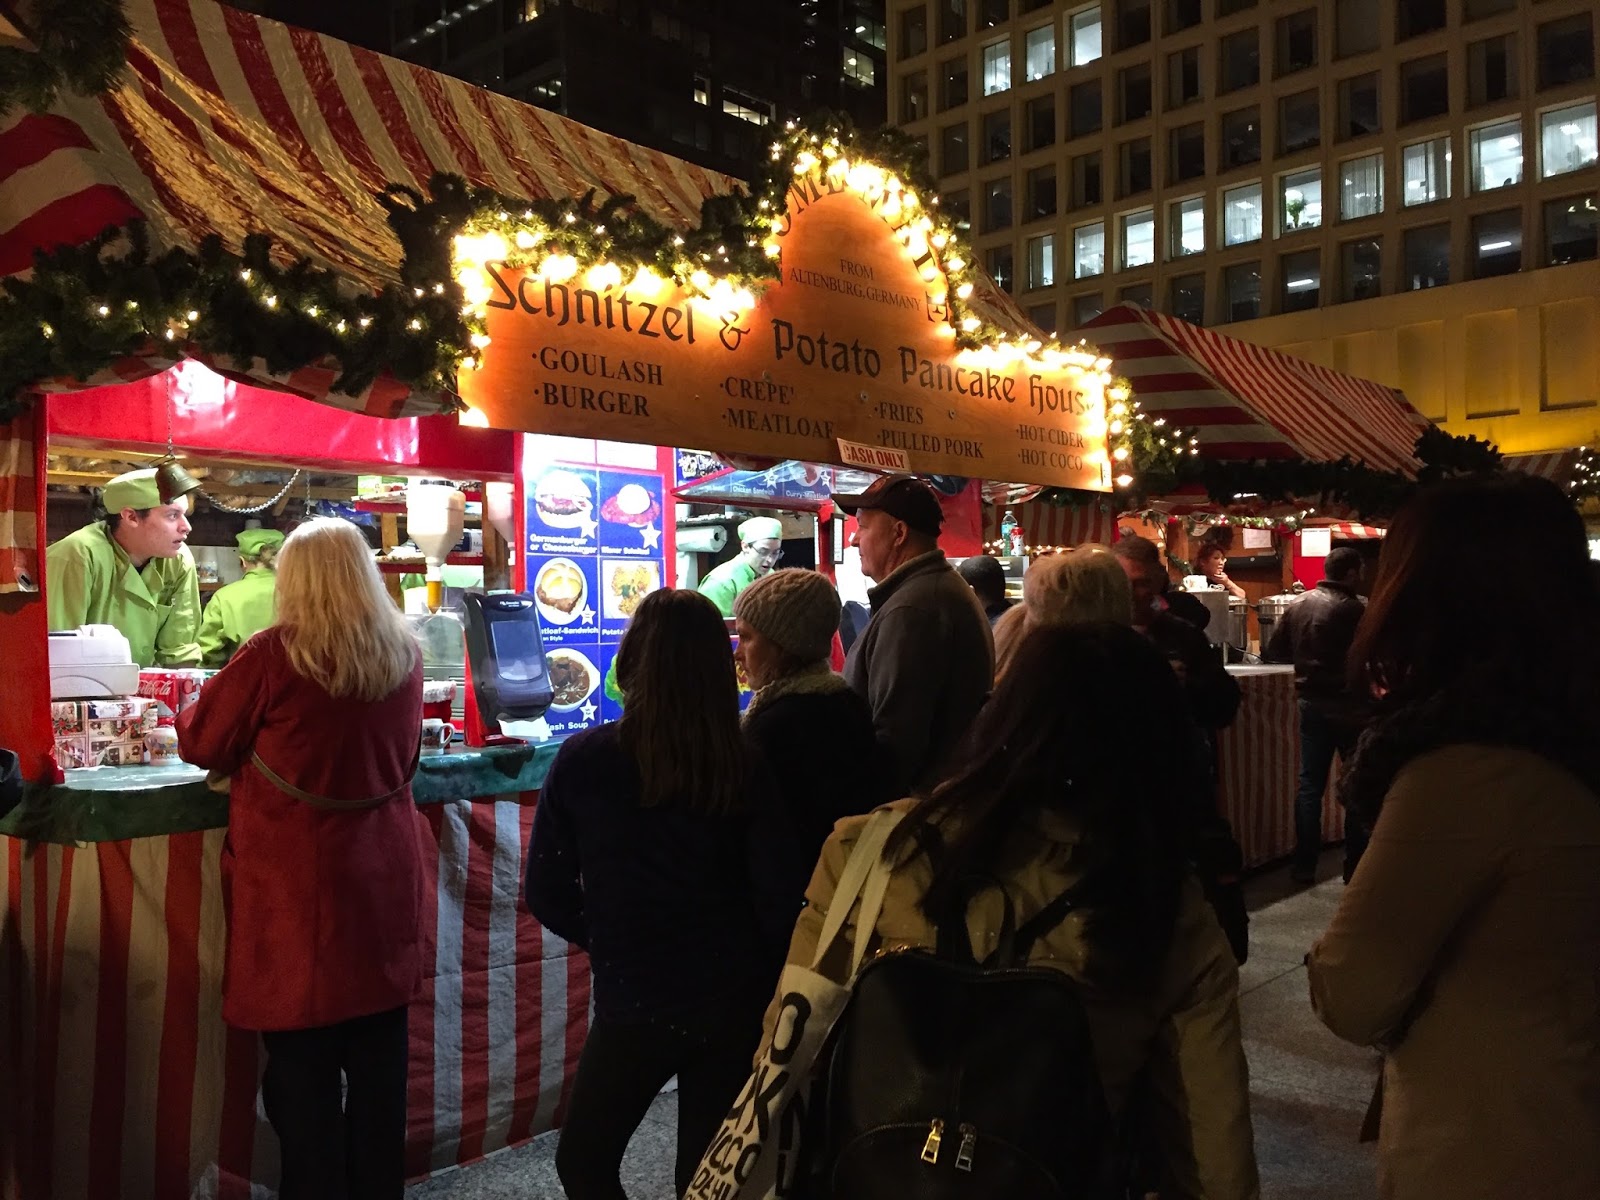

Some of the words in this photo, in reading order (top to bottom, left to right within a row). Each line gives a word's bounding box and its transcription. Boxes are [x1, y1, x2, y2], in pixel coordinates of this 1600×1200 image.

[840, 258, 874, 280] FROM
[485, 260, 695, 344] Schnitzel
[719, 310, 750, 351] &
[771, 318, 880, 378] Potato
[898, 346, 1015, 403] Pancake
[1029, 373, 1094, 416] Hous
[540, 346, 664, 386] GOULASH
[543, 382, 649, 417] BURGER
[728, 408, 833, 440] MEATLOAF
[880, 402, 924, 424] FRIES
[881, 429, 940, 453] PULLED
[945, 438, 984, 458] PORK
[1019, 424, 1046, 441] HOT
[1048, 429, 1084, 448] CIDER
[843, 444, 875, 465] CASH
[877, 449, 905, 469] ONLY
[1021, 449, 1047, 466] HOT
[1050, 452, 1083, 470] COCO
[568, 721, 589, 729] Soup
